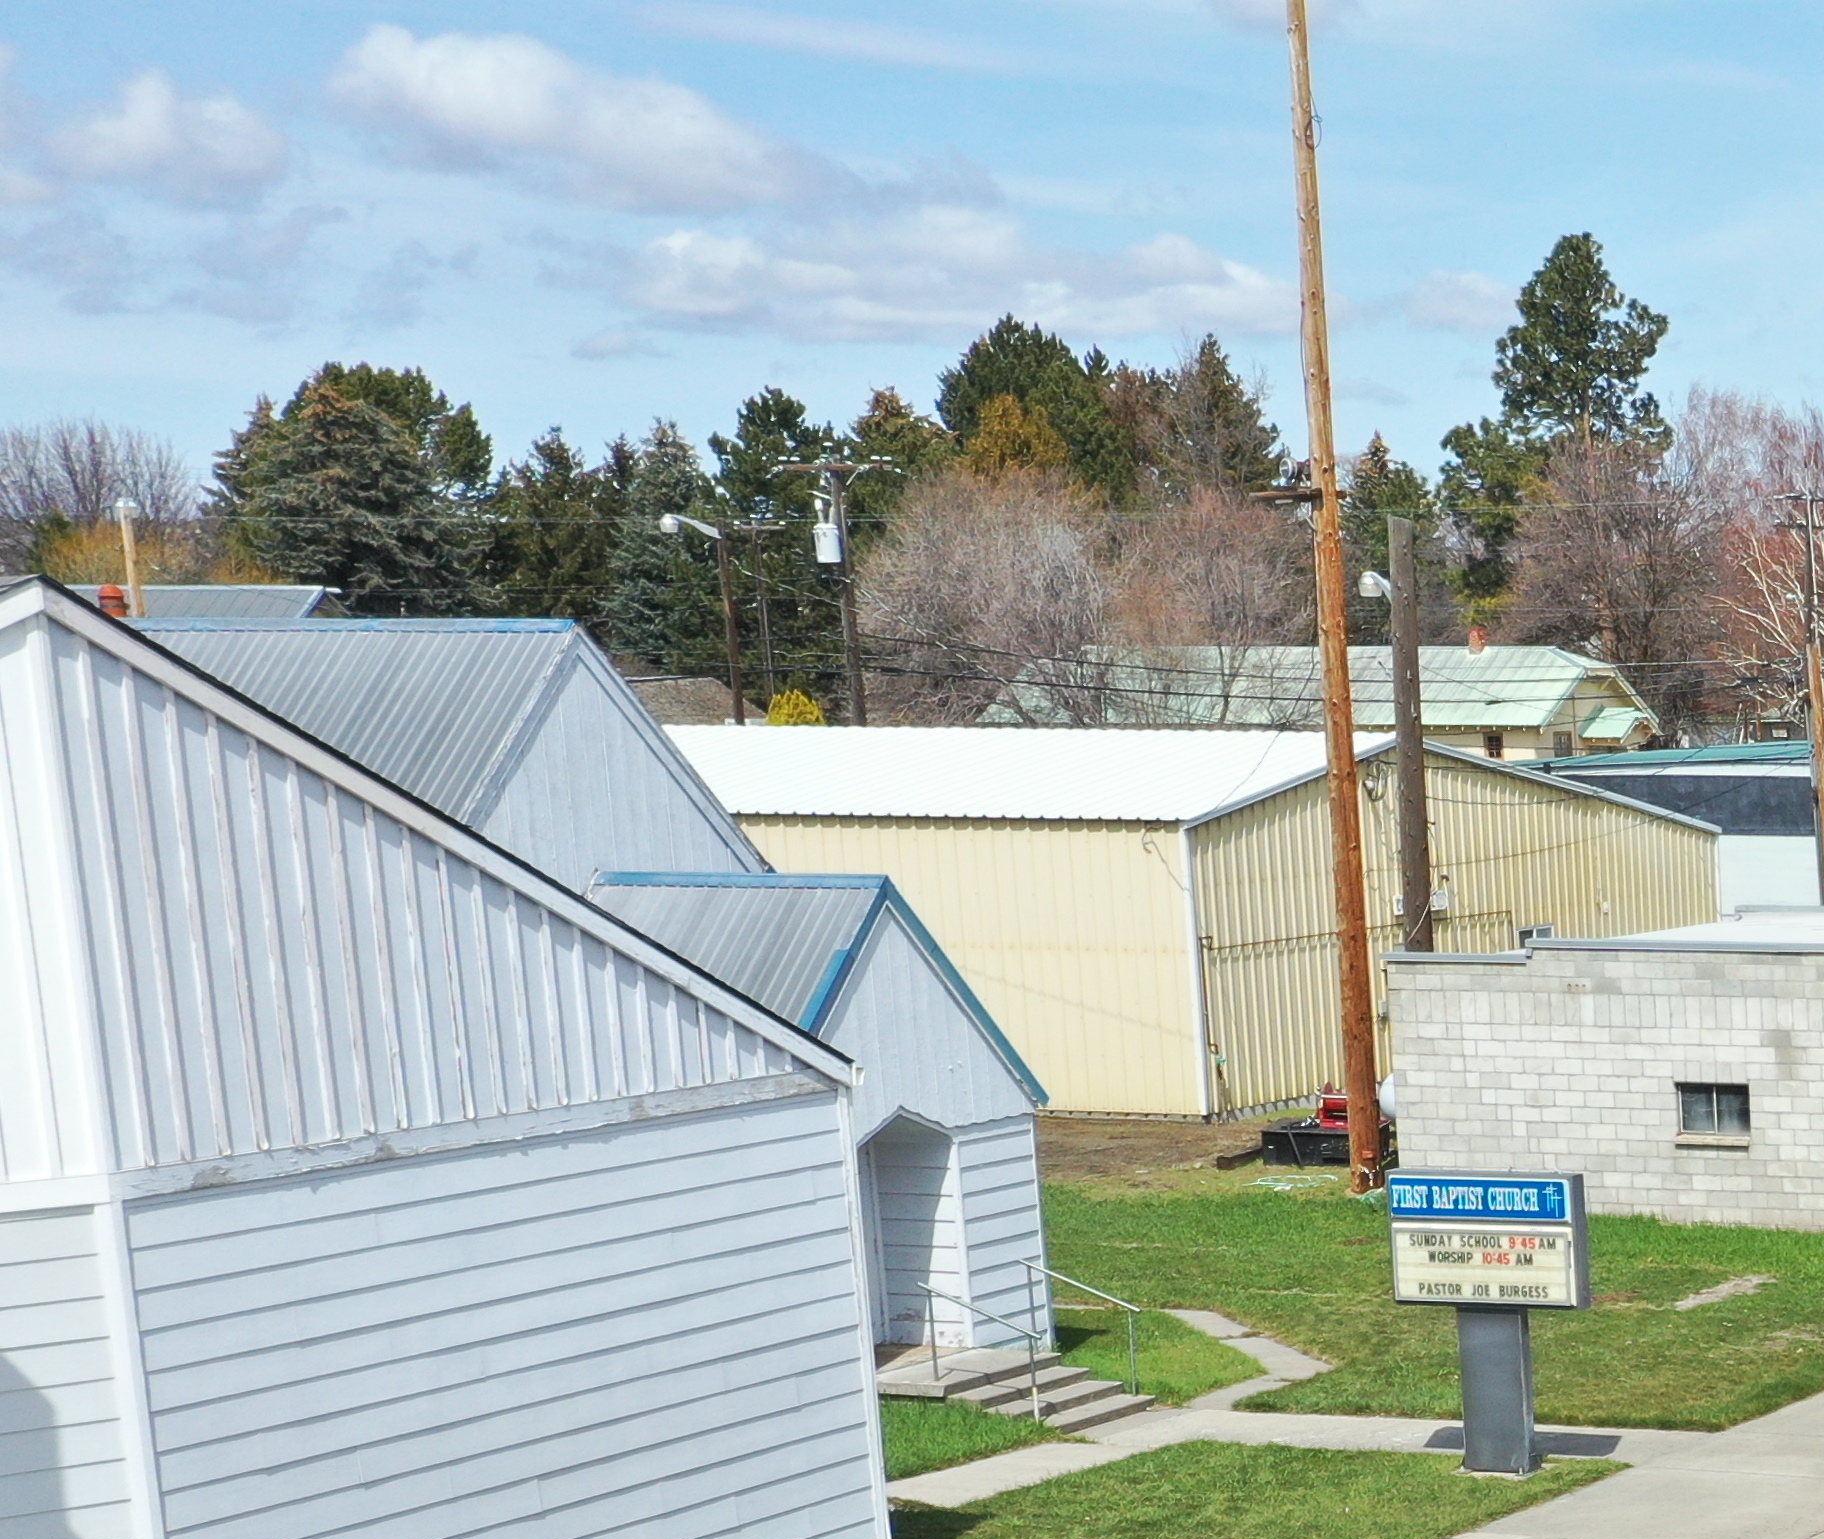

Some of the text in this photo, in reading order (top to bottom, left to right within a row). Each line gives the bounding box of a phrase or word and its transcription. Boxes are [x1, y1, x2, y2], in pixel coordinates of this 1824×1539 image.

[1391, 1185, 1540, 1212] FIRST BAPTIST CHURCH
[1409, 1233, 1557, 1250] SUNDAY SCHOOL 9:45 AM
[1427, 1250, 1534, 1266] WORSHIP 10:45 AM
[1418, 1282, 1549, 1299] PASTOR JOE BURGESS
